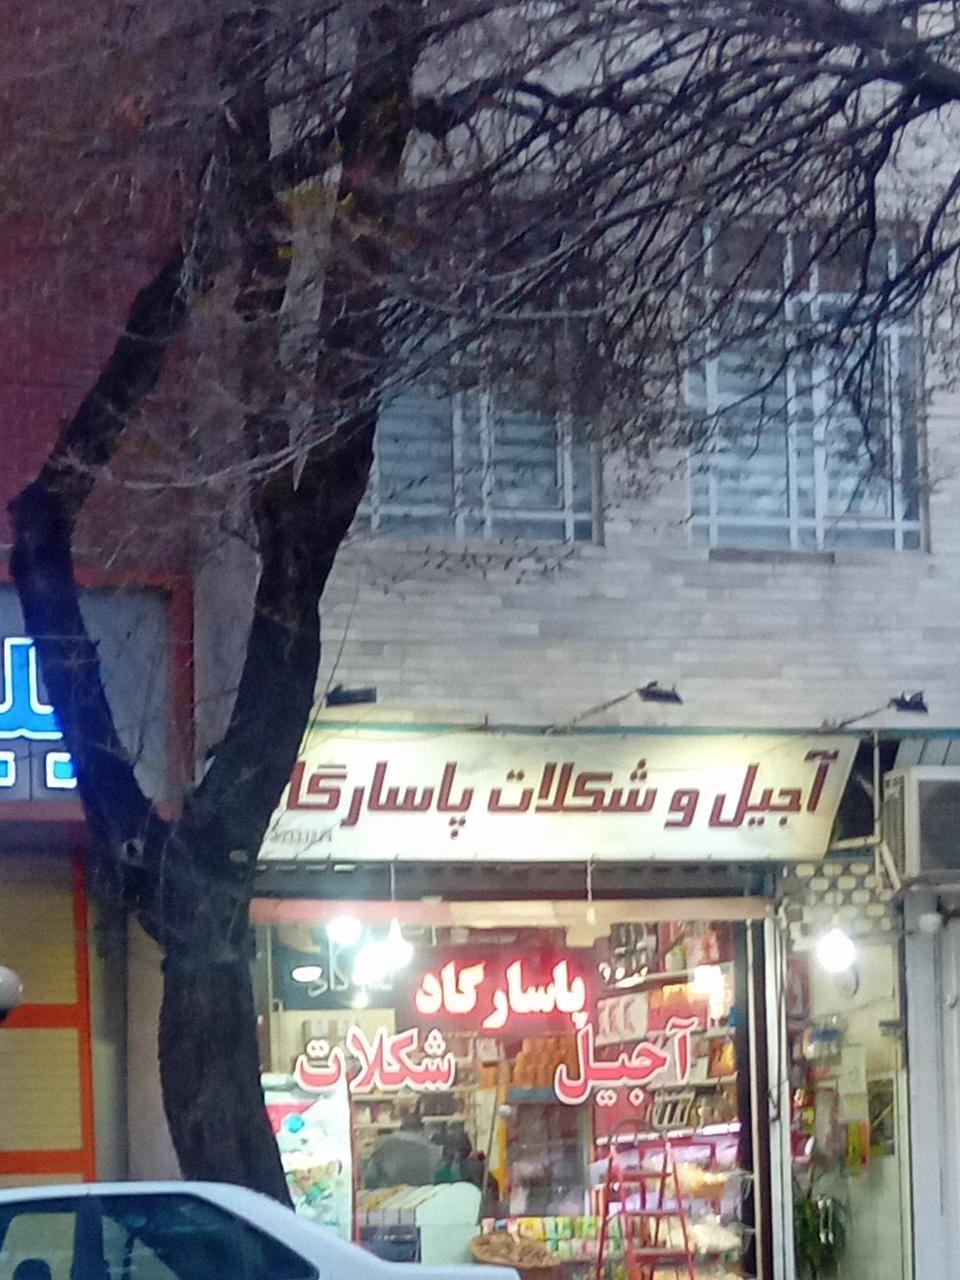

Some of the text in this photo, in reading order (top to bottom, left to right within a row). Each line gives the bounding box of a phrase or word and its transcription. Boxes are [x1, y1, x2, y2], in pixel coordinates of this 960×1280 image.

[286, 748, 840, 840] آجیل و شکلات پاسارگا
[414, 958, 589, 1030] پاسارگاد
[294, 1028, 458, 1093] شکلات
[554, 1014, 700, 1106] آجیل
